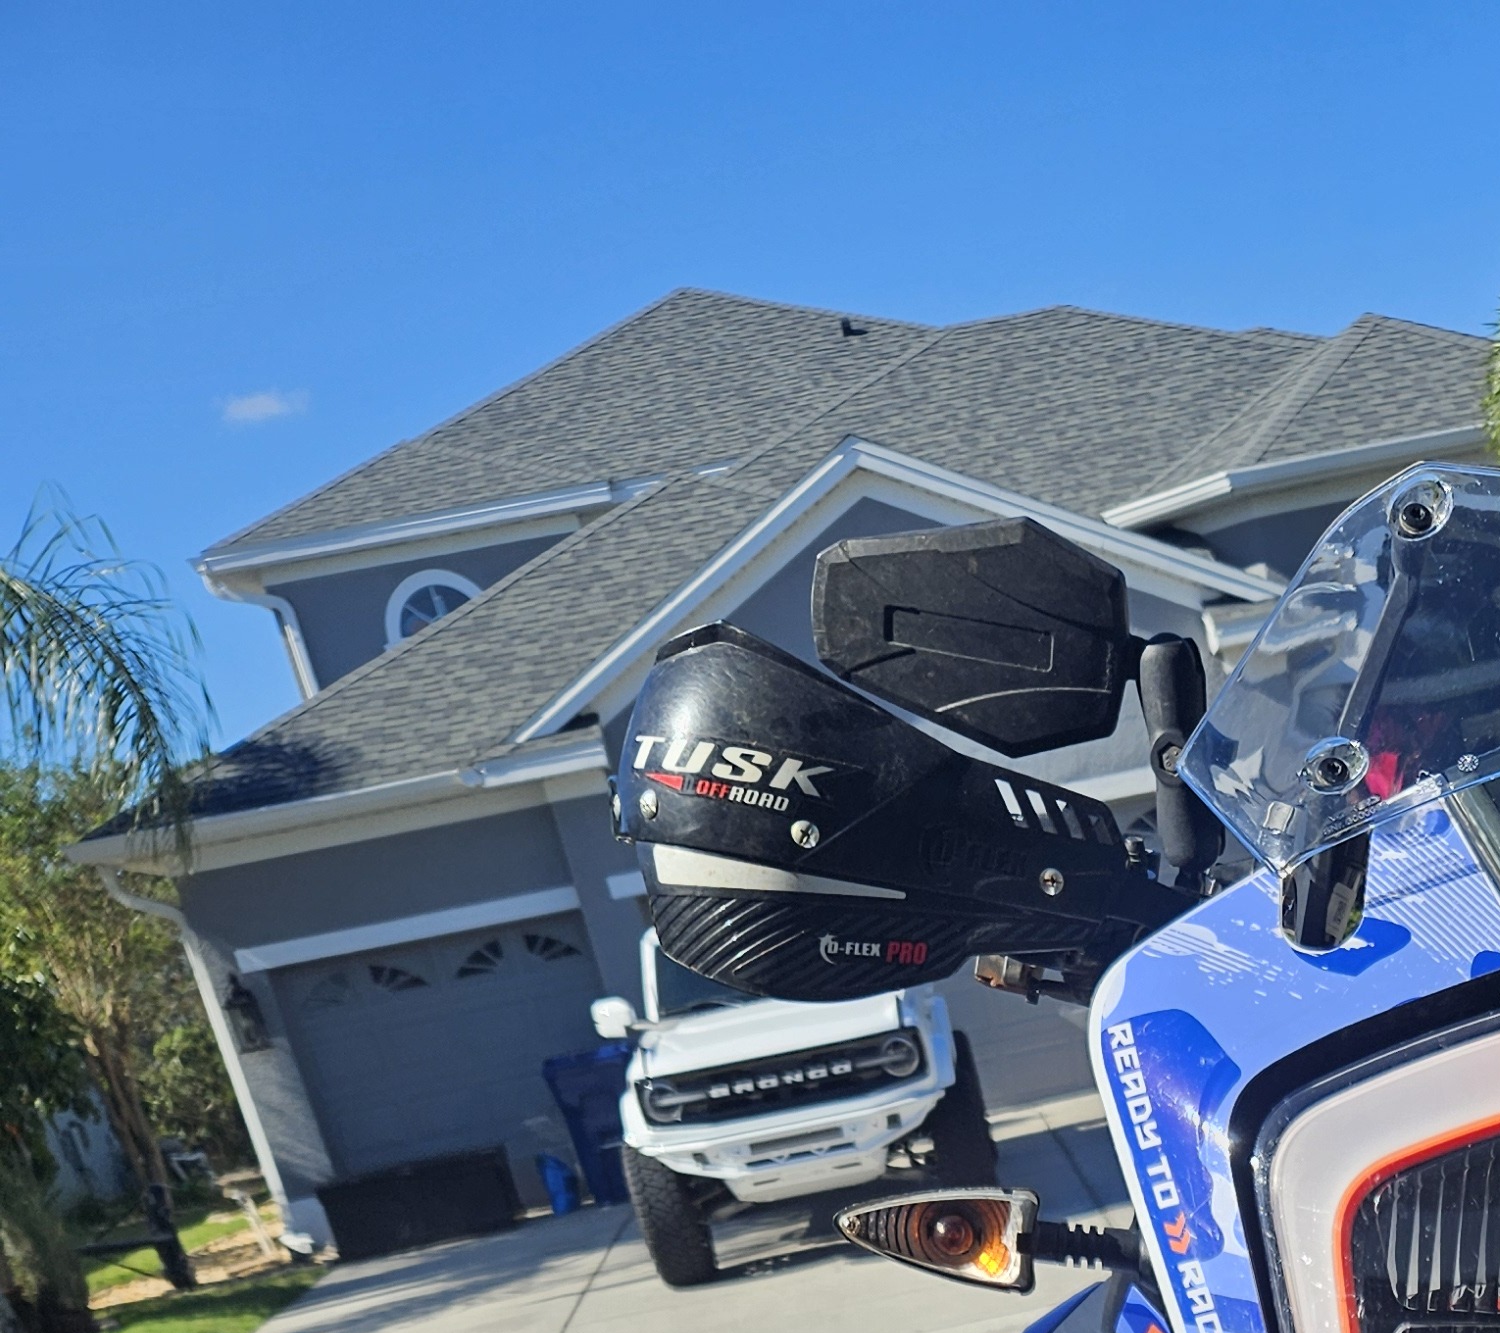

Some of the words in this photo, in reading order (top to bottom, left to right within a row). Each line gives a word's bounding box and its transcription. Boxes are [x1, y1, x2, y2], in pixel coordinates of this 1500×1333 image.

[633, 735, 835, 798] TUSK
[696, 779, 790, 812] OFFROAD
[886, 940, 928, 965] PRO
[708, 1060, 852, 1099] BRONCO
[1107, 1021, 1163, 1151] READY
[1147, 1155, 1181, 1210] TO
